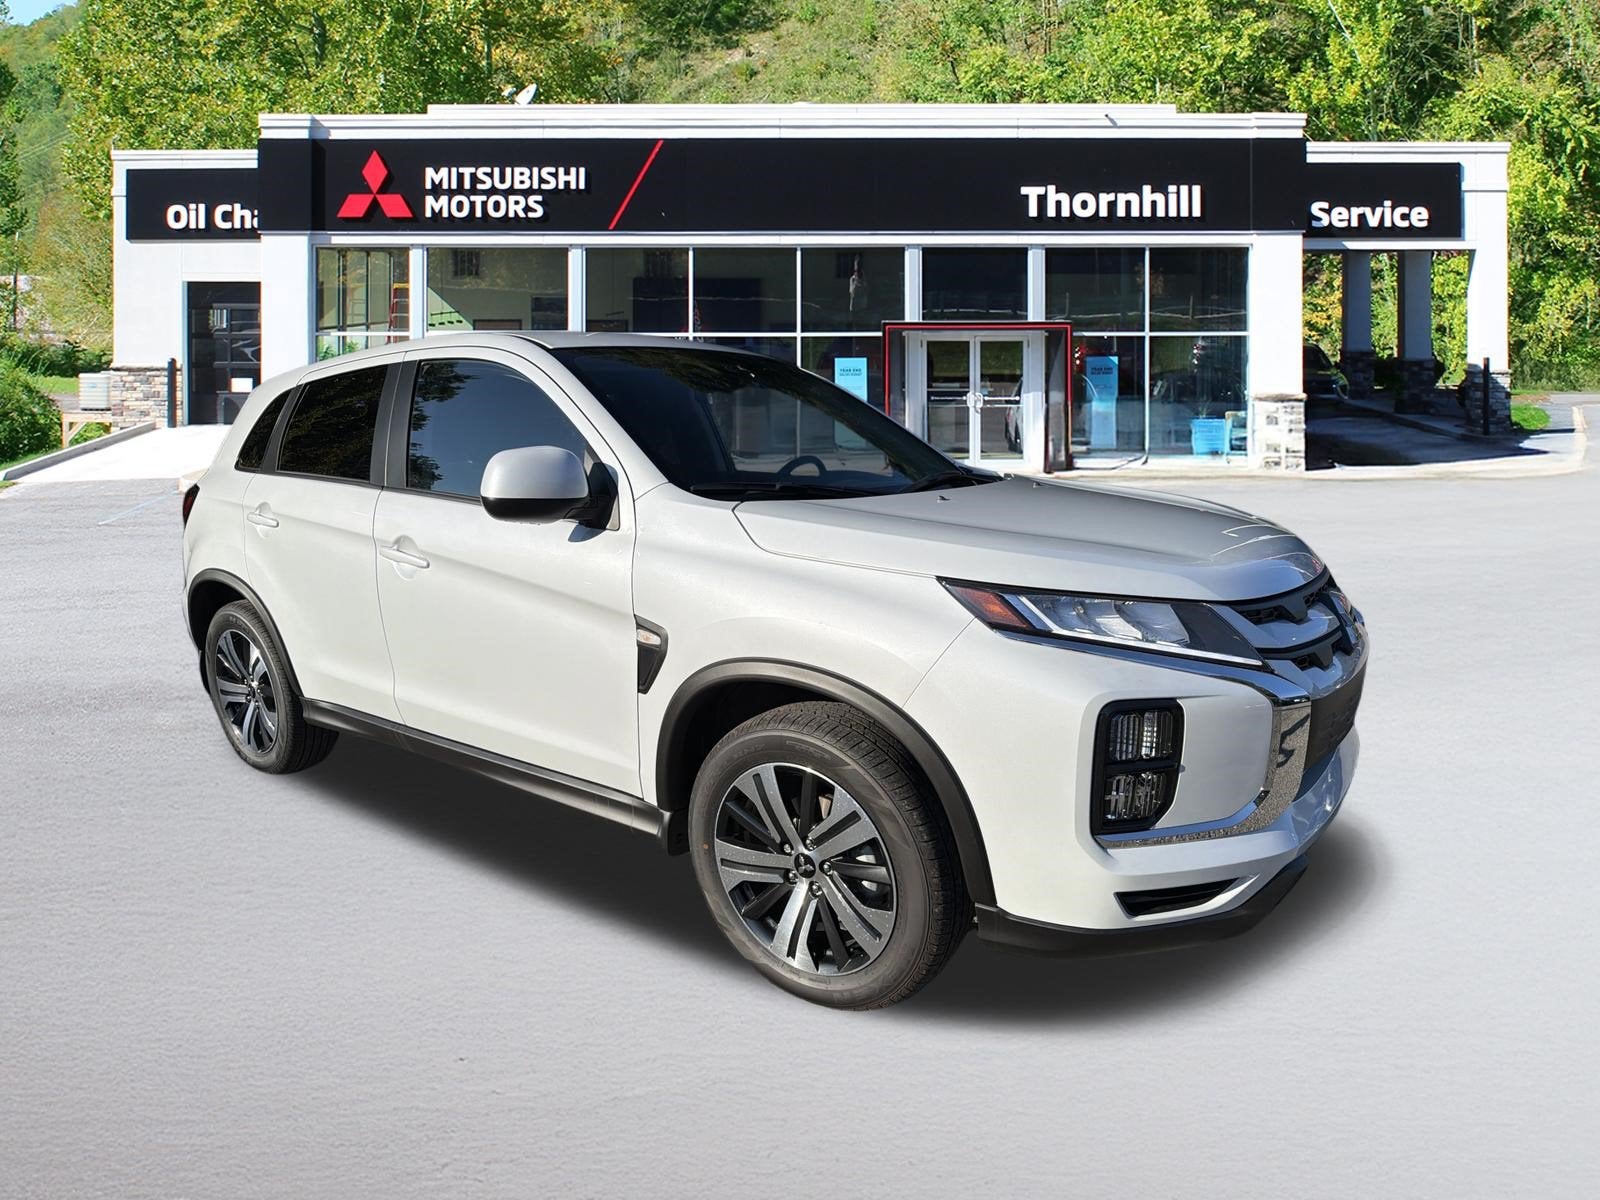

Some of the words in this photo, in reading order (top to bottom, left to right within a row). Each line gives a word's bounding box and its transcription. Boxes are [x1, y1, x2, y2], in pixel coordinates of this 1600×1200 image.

[424, 167, 586, 190] MITSUBISHI
[424, 194, 544, 219] MOTORS
[1020, 185, 1202, 218] Thornhill
[1310, 200, 1429, 228] Service
[166, 203, 206, 229] Oil
